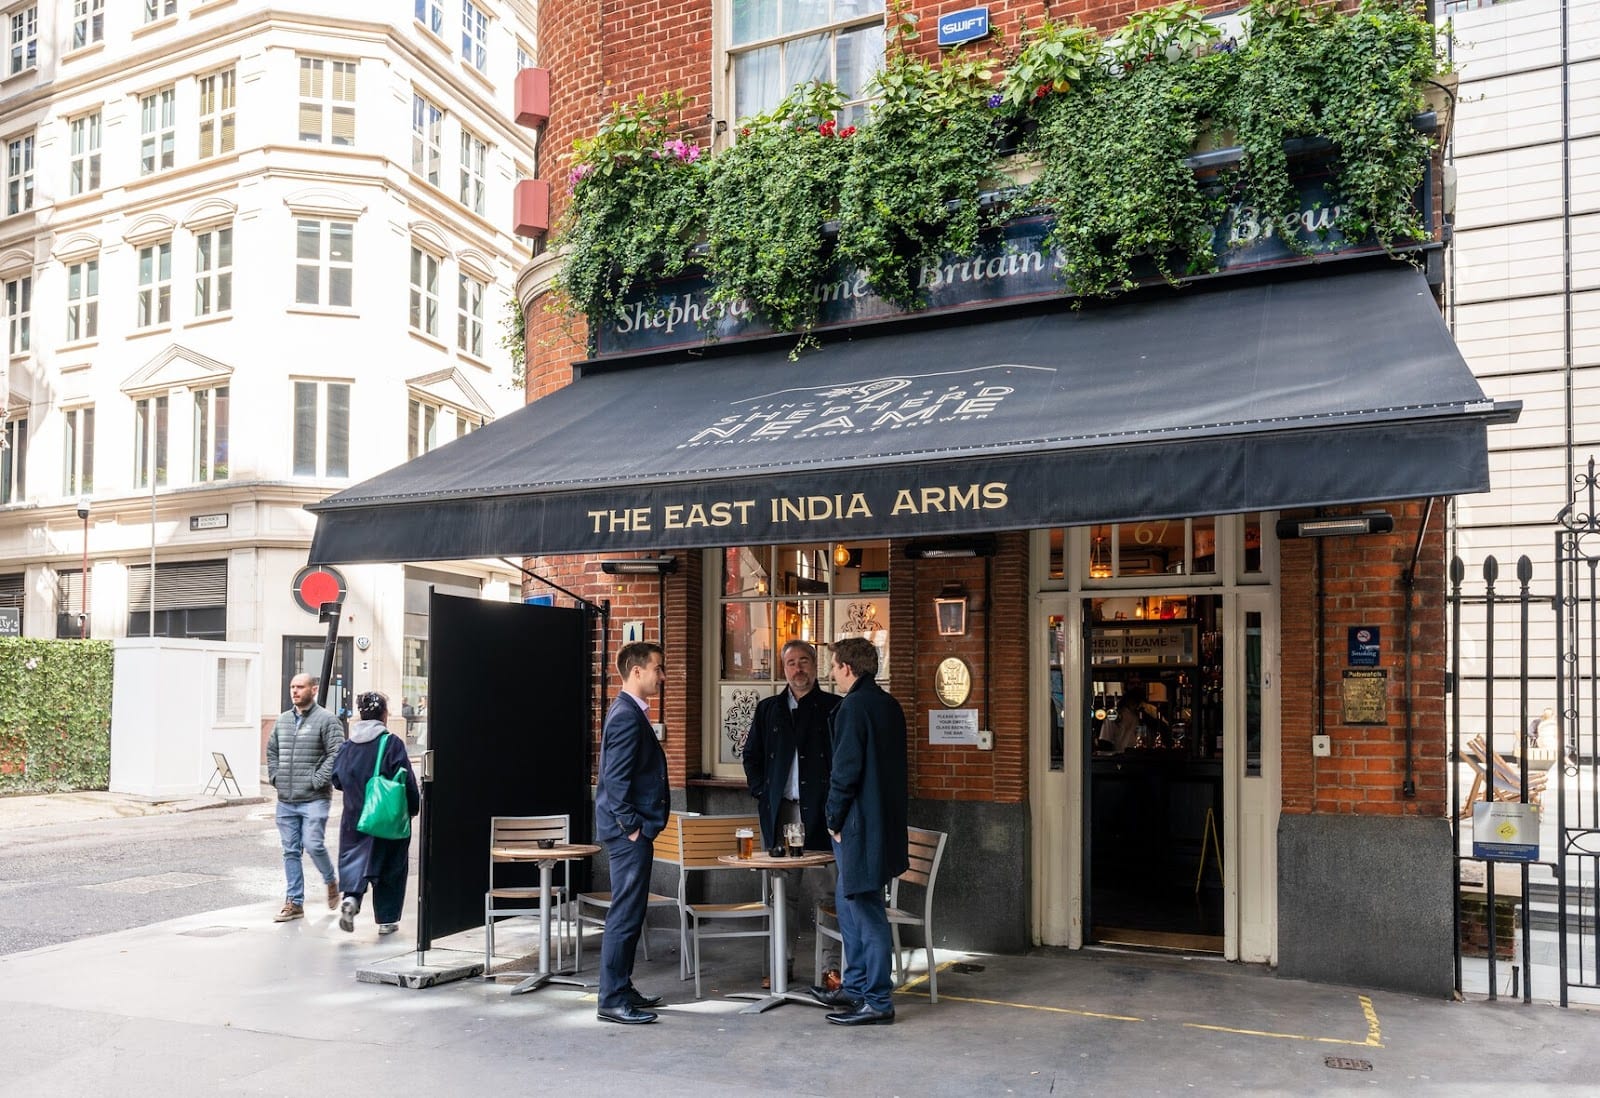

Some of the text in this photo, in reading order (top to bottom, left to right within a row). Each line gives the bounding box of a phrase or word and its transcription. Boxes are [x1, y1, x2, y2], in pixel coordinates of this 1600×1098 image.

[942, 16, 985, 35] SWIFT
[916, 246, 1069, 289] Britains
[688, 396, 1004, 442] NEAME
[713, 386, 1015, 426] SHEPHERD
[588, 482, 1009, 533] THE EAST INDIA ARMS
[1134, 520, 1170, 545] 67
[1124, 635, 1168, 648] NEAME
